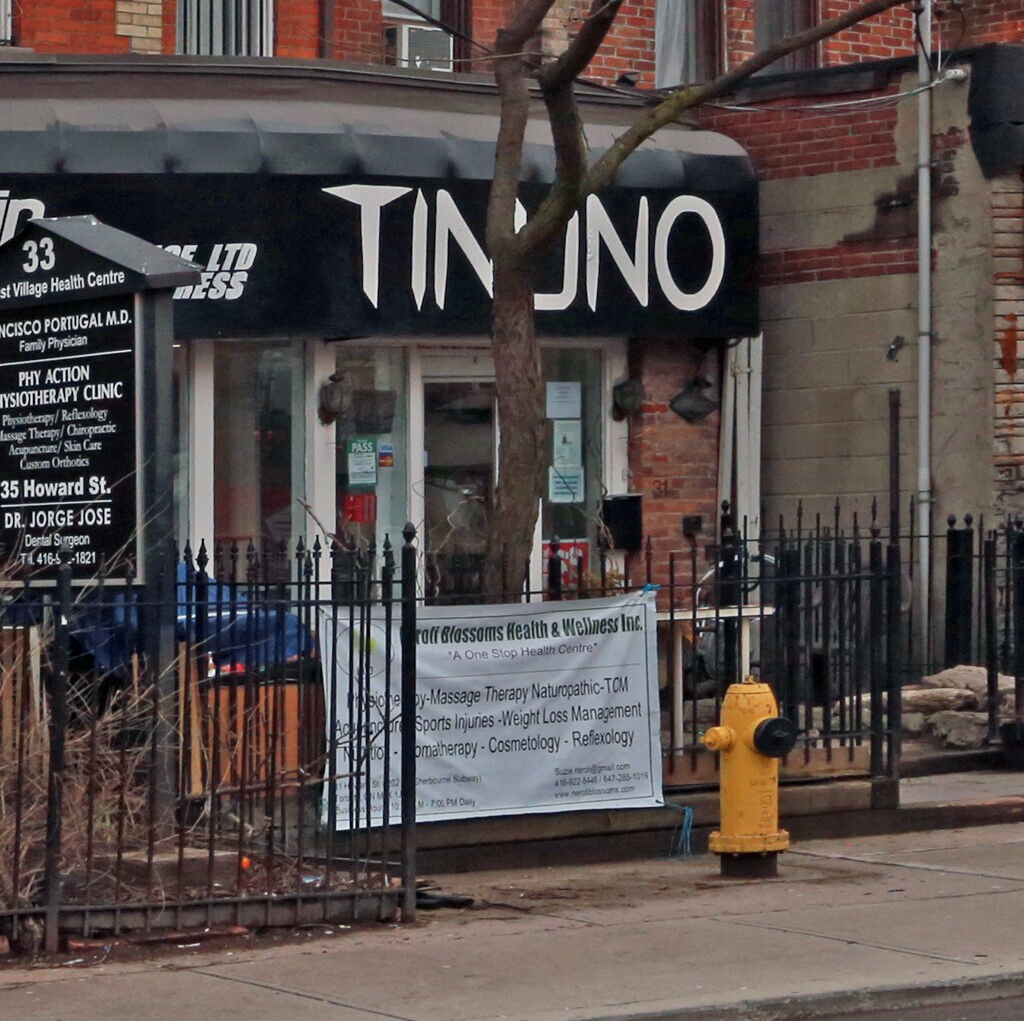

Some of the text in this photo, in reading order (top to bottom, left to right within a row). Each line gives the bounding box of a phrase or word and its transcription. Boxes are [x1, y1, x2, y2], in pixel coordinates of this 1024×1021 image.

[22, 237, 56, 273] 33
[206, 243, 257, 271] LTD
[13, 279, 48, 300] Village
[50, 273, 85, 293] Health
[87, 268, 125, 288] Centre
[44, 312, 103, 333] PORTUGAL
[105, 309, 132, 327] M.D.
[20, 334, 88, 353] Family Physician
[19, 365, 90, 387] PHY ACTION
[84, 382, 123, 401] CLINIC
[61, 407, 108, 422] Reflexology
[67, 421, 117, 438] Chiropractic
[64, 440, 82, 452] Skin
[83, 439, 102, 451] Care
[351, 441, 373, 453] PASS
[20, 455, 90, 470] Custom Orthotics
[0, 475, 112, 499] 35 Howard St.
[5, 508, 111, 529] DR. JORGE JOSE
[25, 534, 52, 547] Dental
[440, 624, 504, 645] Blossoms
[506, 620, 549, 641] Health
[551, 623, 560, 638] &
[562, 617, 620, 637] Wellness
[621, 613, 643, 633] Inc.
[464, 649, 489, 661] One
[491, 647, 518, 661] Stop
[521, 644, 556, 658] Health
[485, 685, 529, 705] Therapy
[415, 714, 451, 735] Sports
[454, 713, 494, 734] Injuries
[542, 708, 568, 724] Loss
[571, 702, 643, 723] Management
[488, 733, 560, 754] Cosmetology
[572, 729, 634, 748] Reflexology
